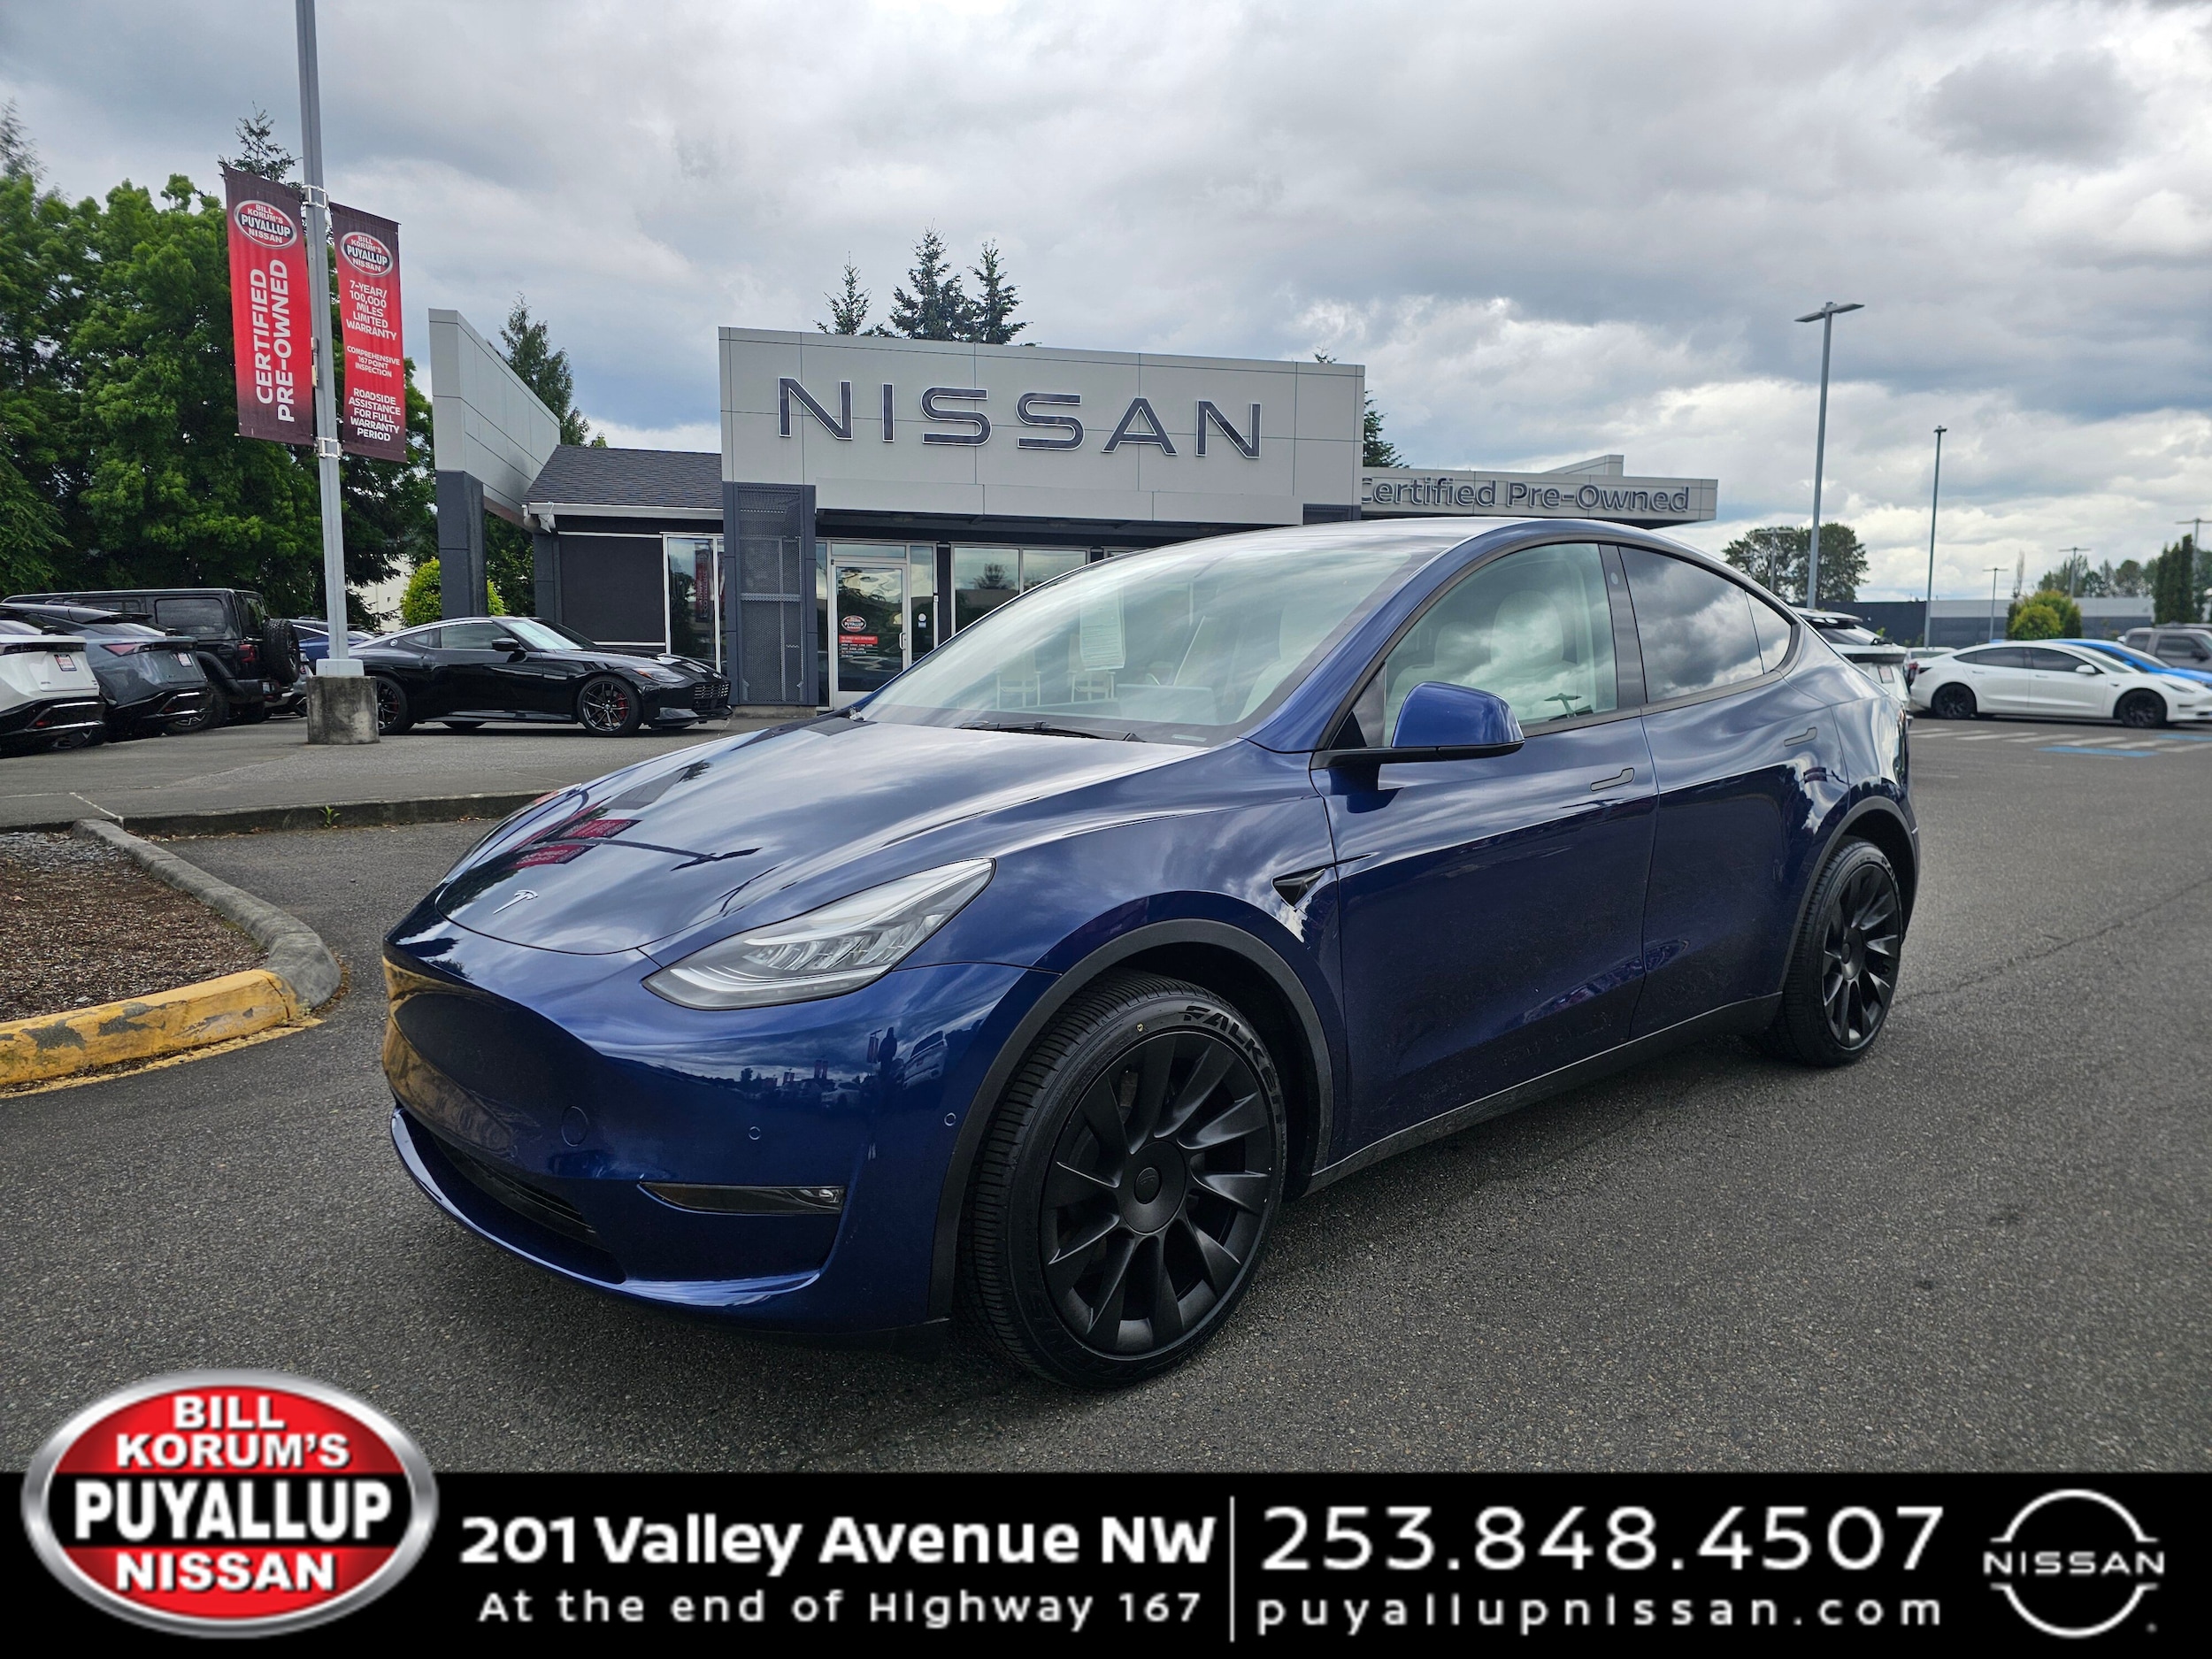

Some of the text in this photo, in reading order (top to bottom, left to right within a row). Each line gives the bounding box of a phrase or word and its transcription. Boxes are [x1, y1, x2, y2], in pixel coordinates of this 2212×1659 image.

[247, 208, 284, 224] KORUM'S
[255, 204, 273, 215] BILL
[241, 213, 291, 237] PUYALLUP
[249, 227, 283, 244] NISSAN
[357, 235, 373, 246] BILL
[346, 244, 388, 266] PUYALLUP
[350, 239, 382, 254] KORUM'S
[352, 257, 381, 273] NISSAN
[349, 280, 388, 299] 7-YEAR/
[349, 289, 387, 309] 100,000
[352, 311, 388, 328] LIMITED
[357, 302, 384, 318] MILES
[250, 268, 273, 404] CERTIFIED
[346, 319, 397, 341] WARRANTY
[269, 259, 295, 422] PRE-OWNED
[346, 345, 401, 366] COMPREHENSIVE
[357, 355, 389, 370] 167 POINT
[355, 362, 393, 378] INSPECTION
[348, 396, 402, 416] ASSISTANCE
[353, 387, 396, 406] ROADSIDE
[349, 415, 400, 434] WARRANTY
[354, 406, 395, 425] FOR FULL
[778, 376, 1262, 459] NISSAN
[357, 426, 391, 442] PERIOD
[1506, 481, 1690, 512] Pre-Owned
